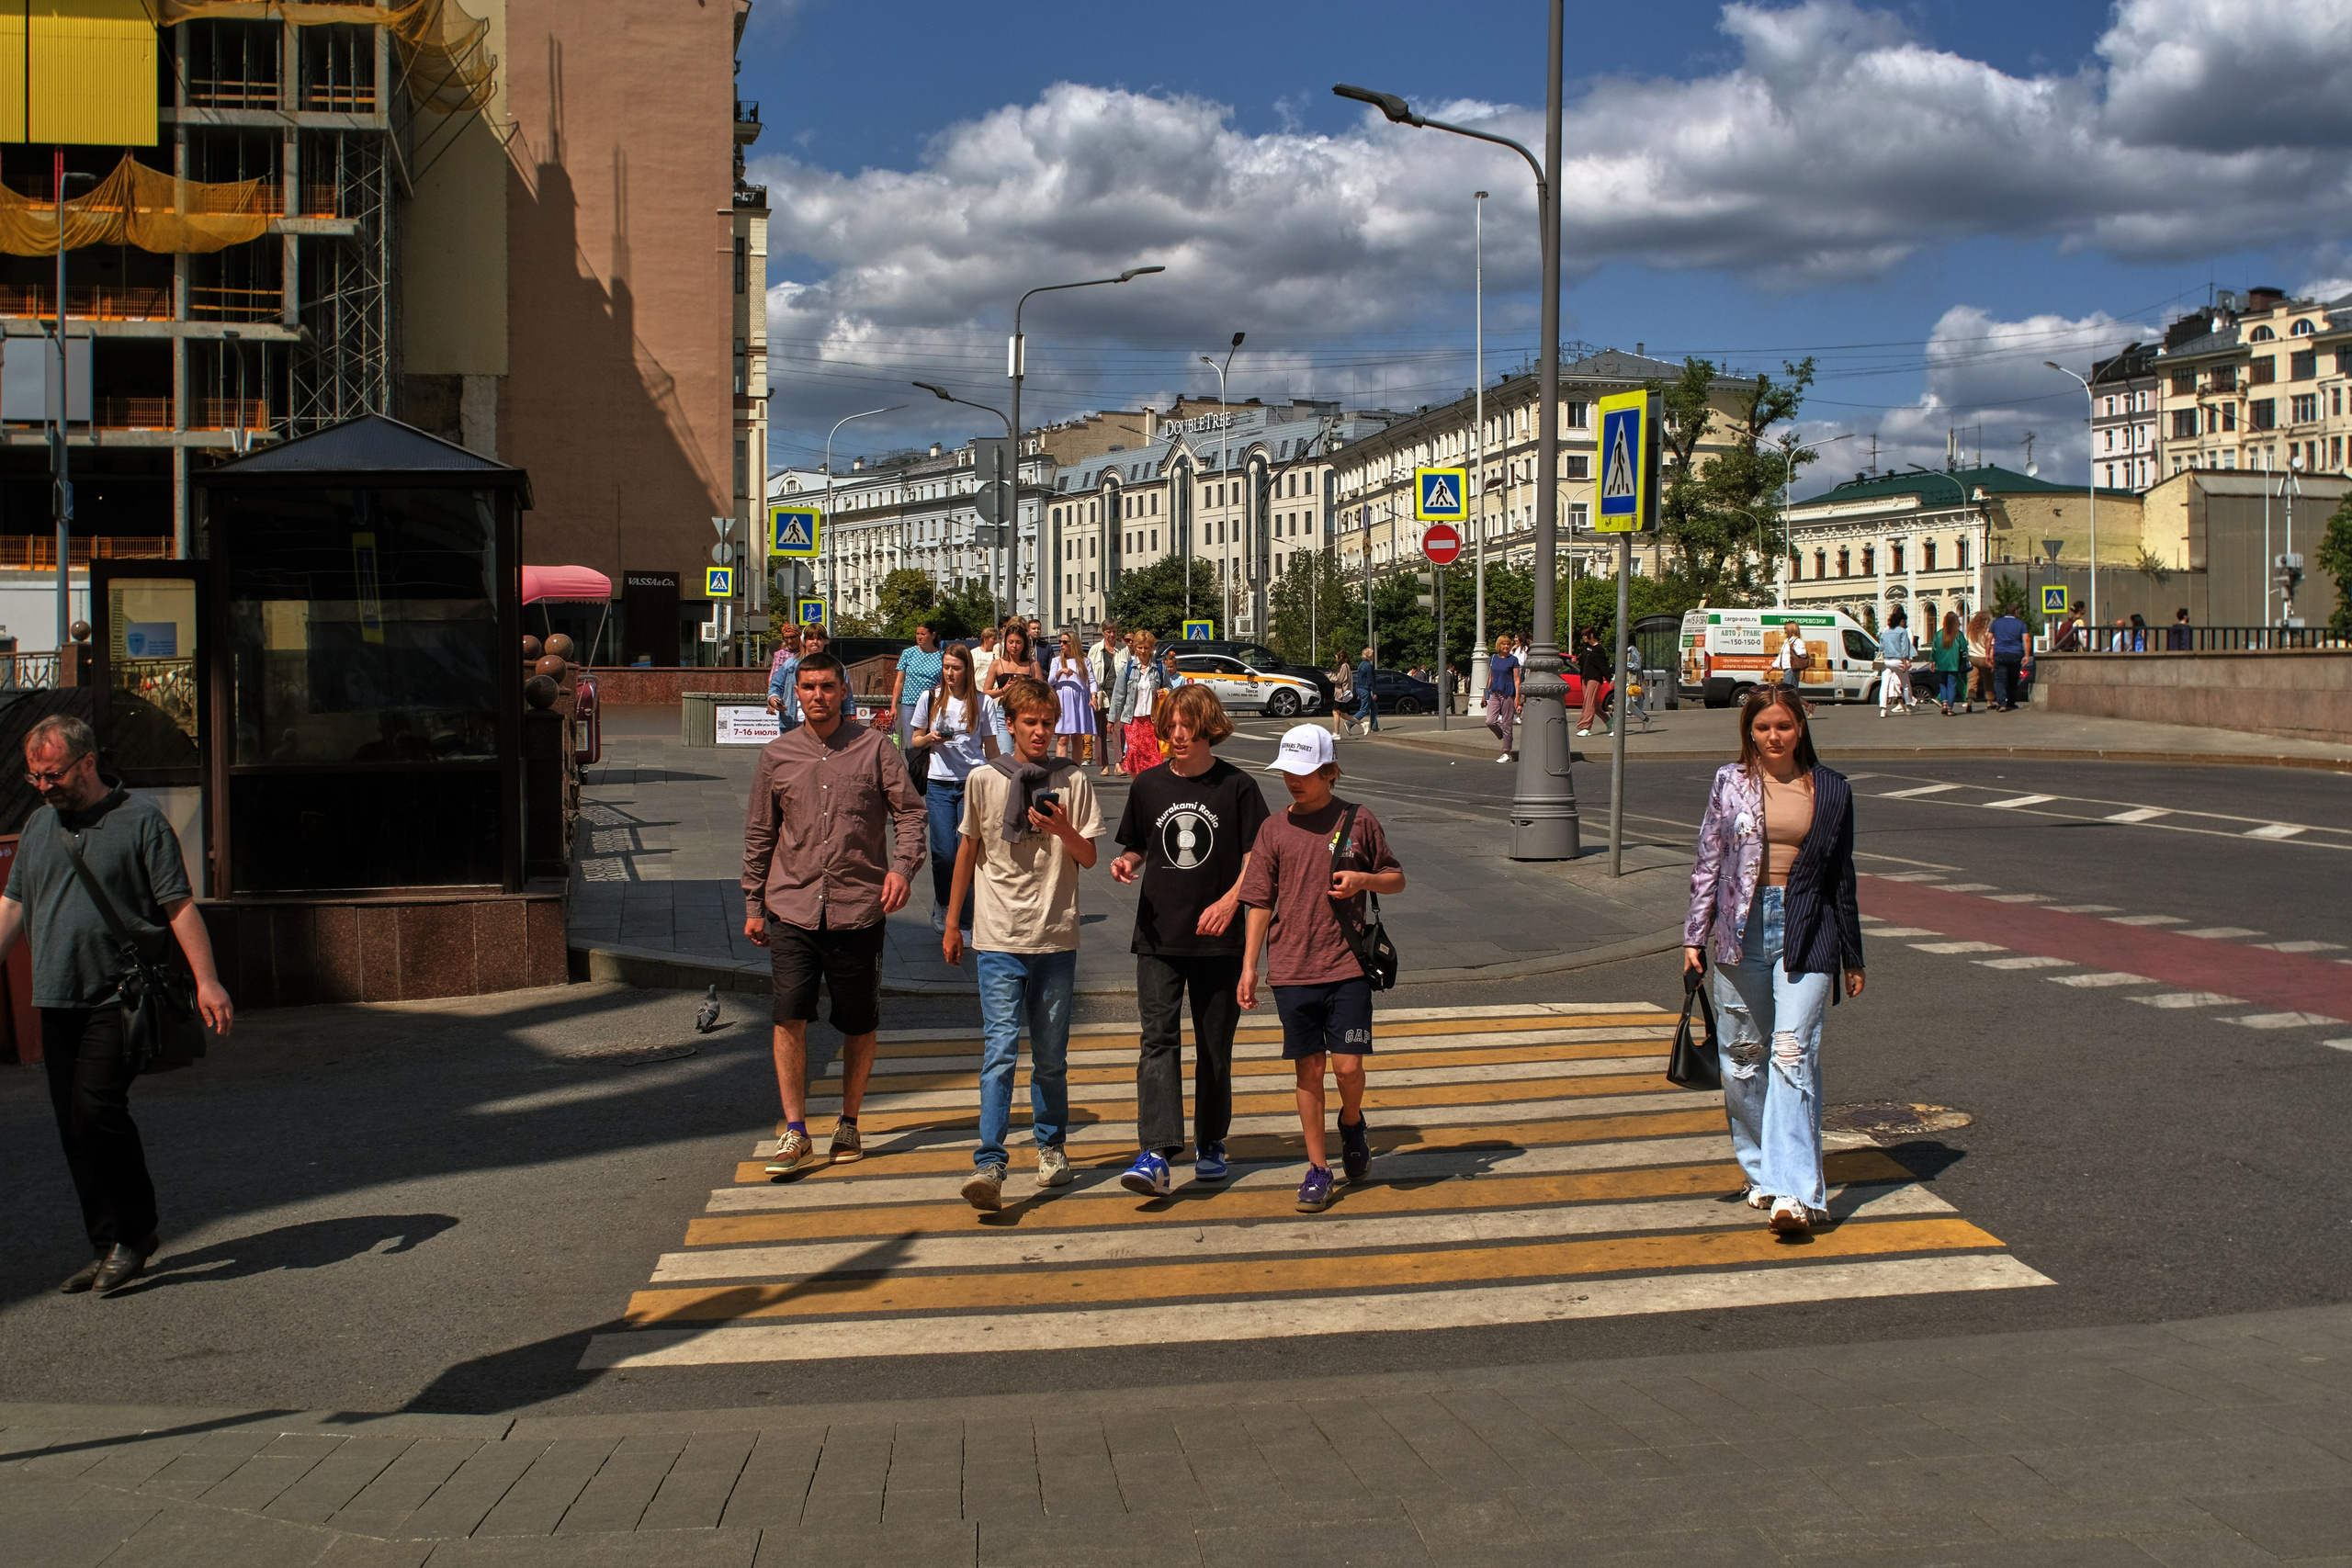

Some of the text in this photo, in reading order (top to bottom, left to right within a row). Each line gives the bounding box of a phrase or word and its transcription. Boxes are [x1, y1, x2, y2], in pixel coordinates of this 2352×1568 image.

[1155, 801, 1219, 828] Murakami Radio
[1345, 1028, 1370, 1044] GAP
